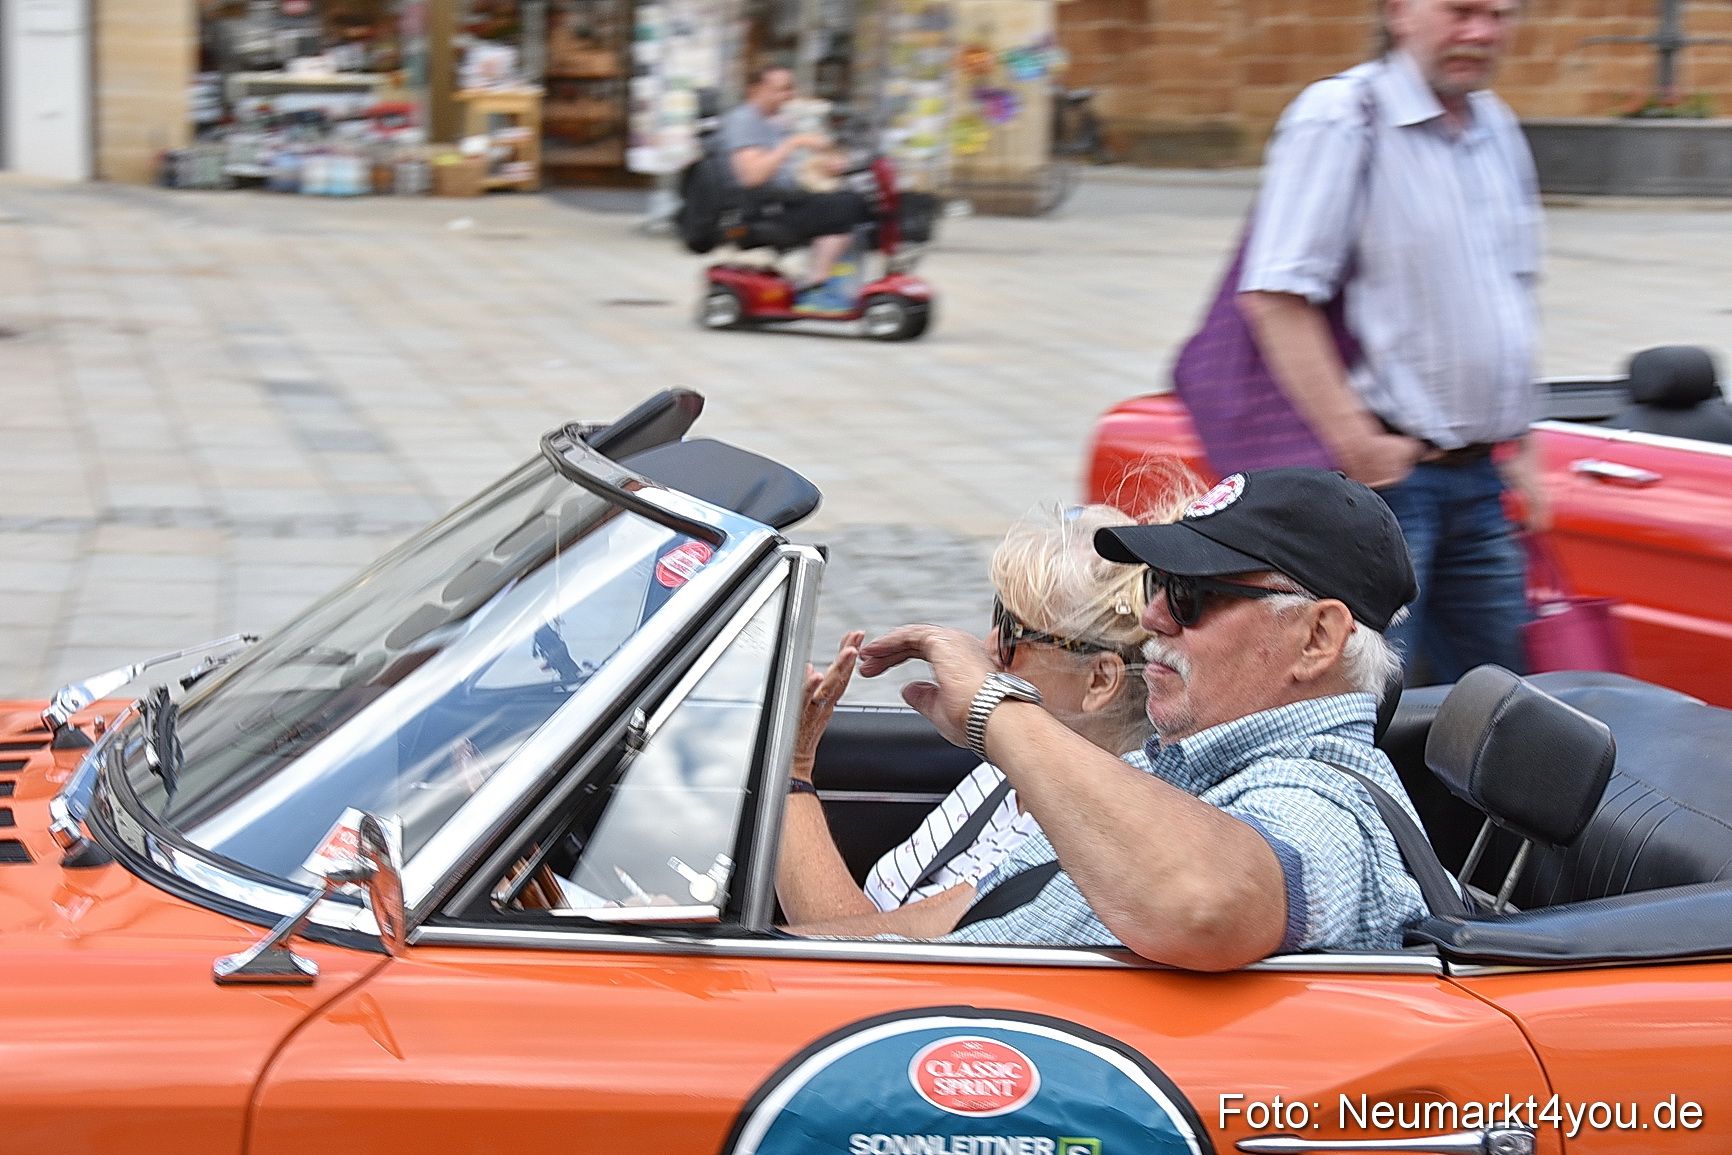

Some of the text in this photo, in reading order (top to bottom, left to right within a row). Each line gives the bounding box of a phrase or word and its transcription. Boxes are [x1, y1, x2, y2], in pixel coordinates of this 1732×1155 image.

[925, 1059, 1023, 1079] CLASSIC
[933, 1077, 1018, 1097] SPRINT
[849, 1133, 1056, 1155] SONNLEITNER
